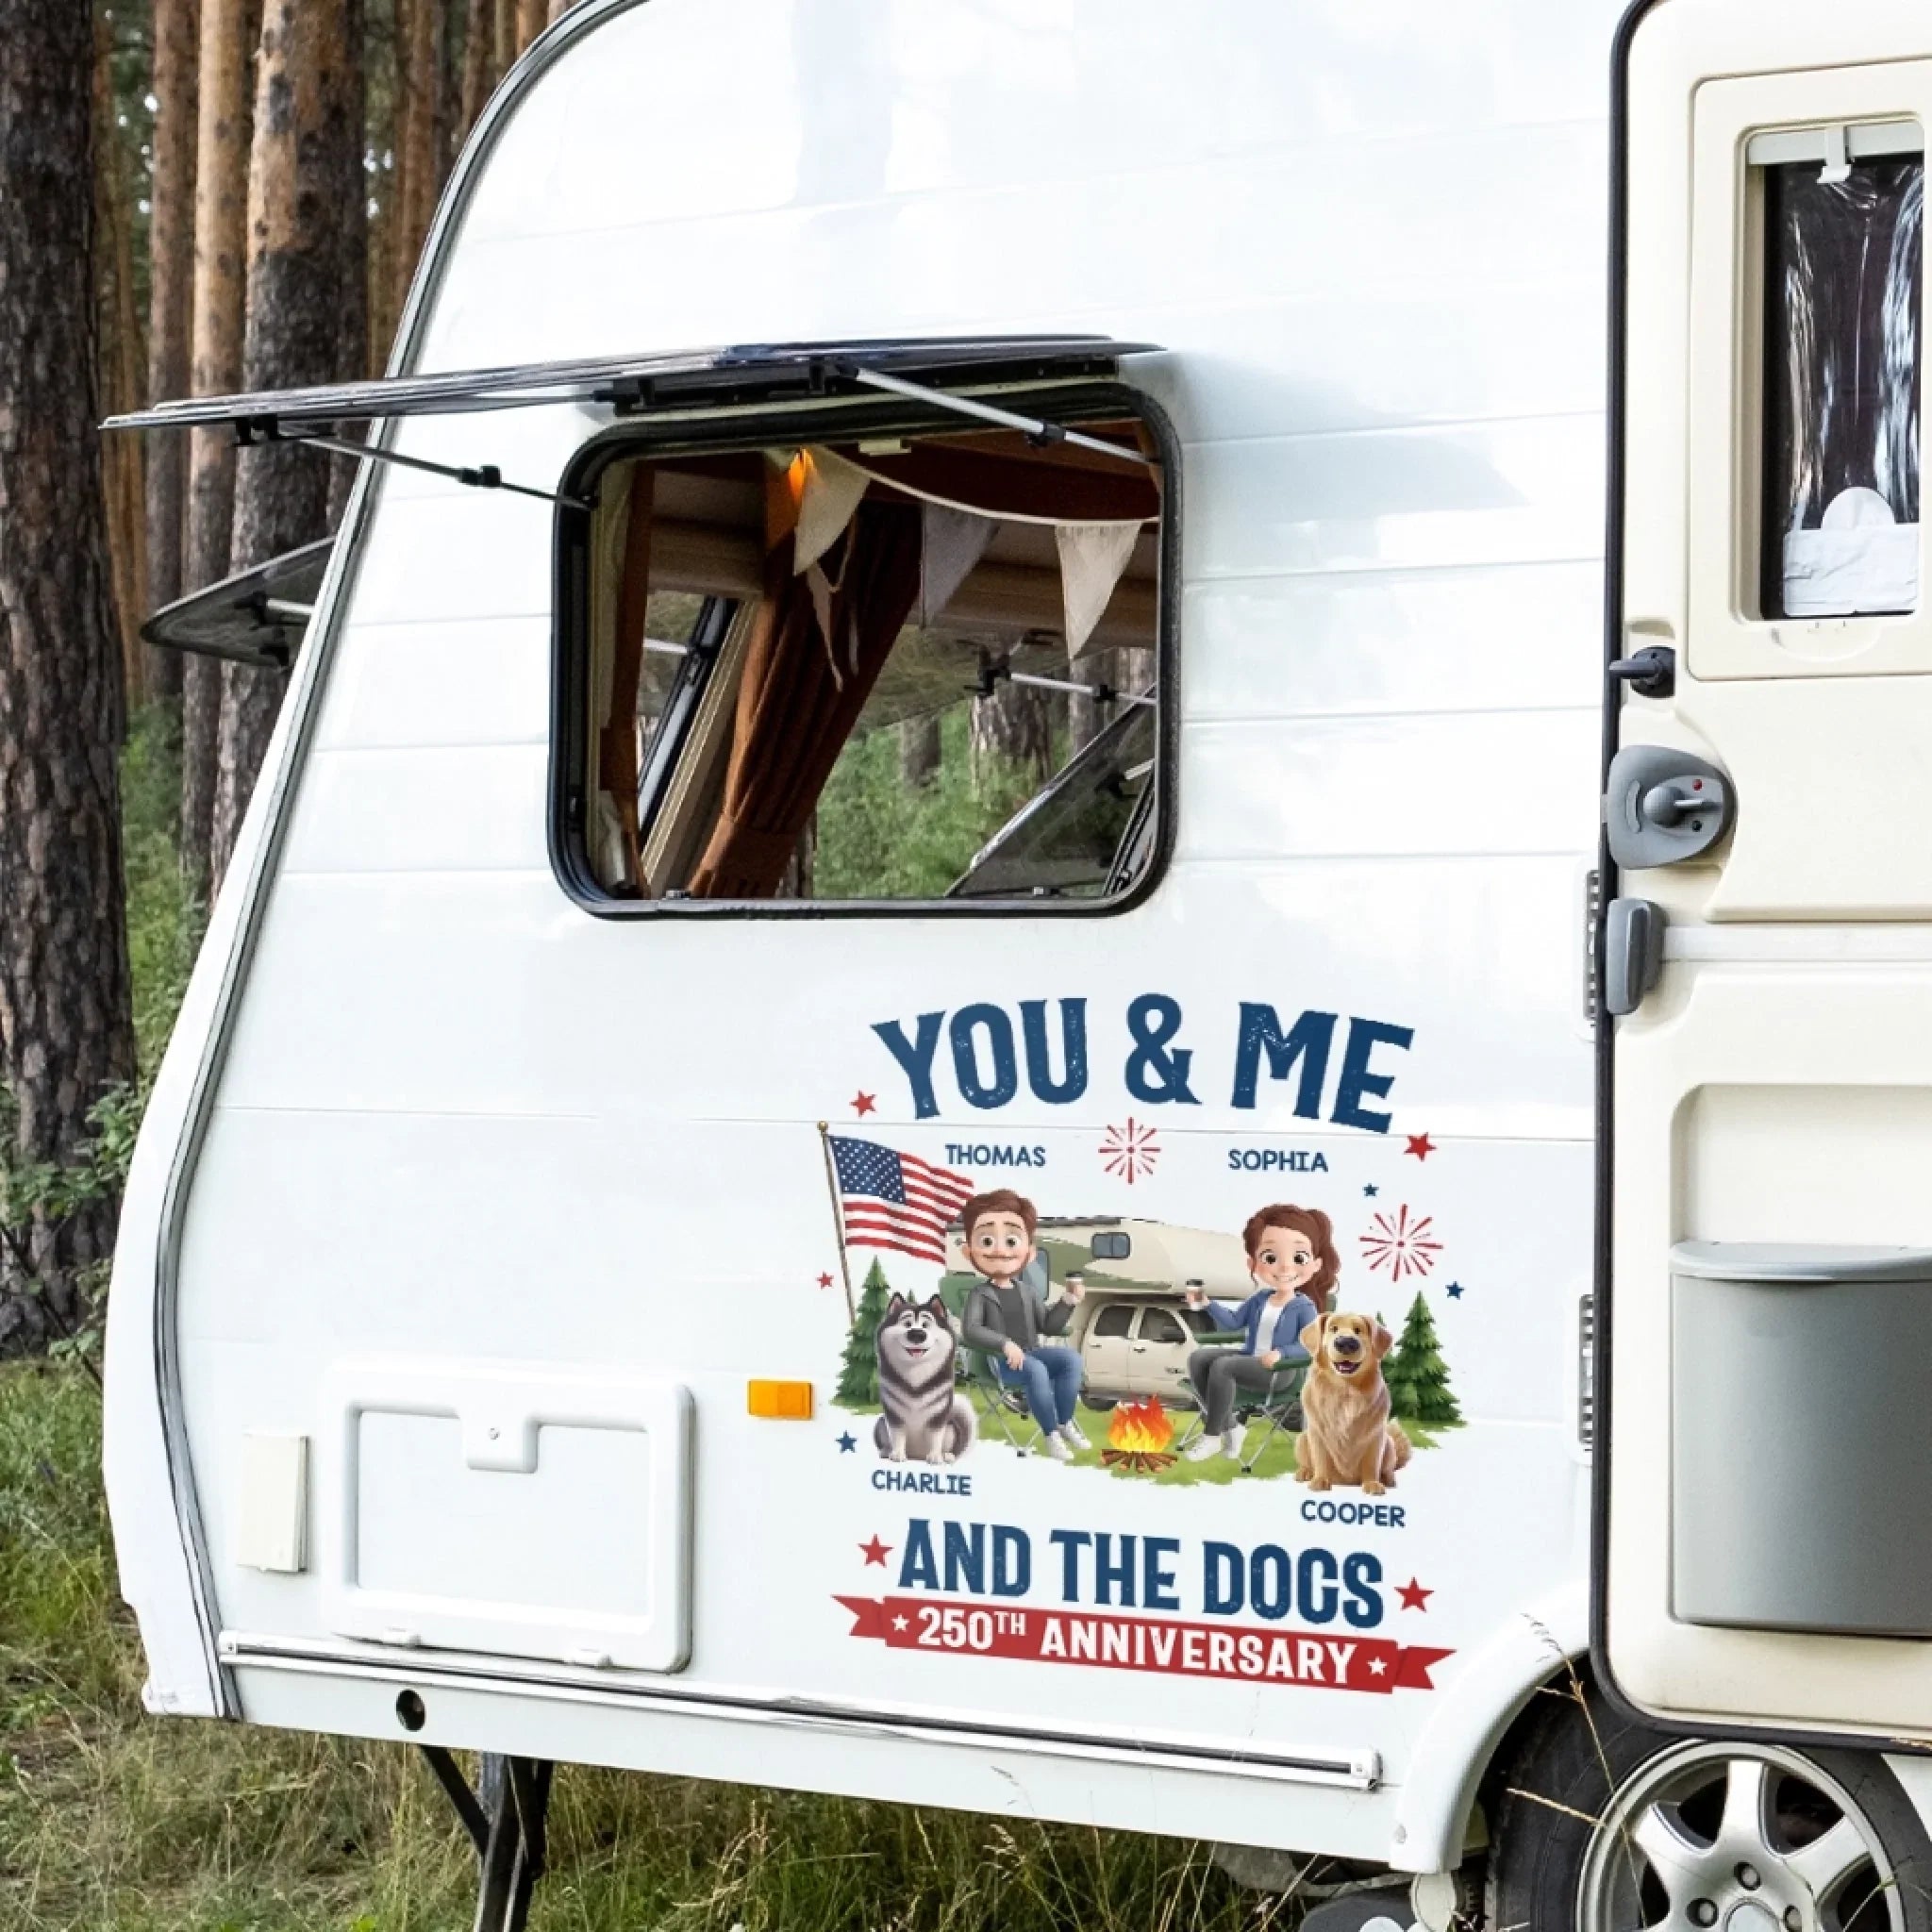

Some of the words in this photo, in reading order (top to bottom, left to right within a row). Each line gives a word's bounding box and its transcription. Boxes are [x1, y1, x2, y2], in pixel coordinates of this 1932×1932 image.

[871, 997, 1090, 1120] YOU
[1124, 993, 1203, 1105] &
[1229, 1001, 1416, 1135] ME
[944, 1144, 1046, 1167] THOMAS
[1227, 1148, 1329, 1173] SOPHIA
[871, 1469, 971, 1497] CHARLIE
[1301, 1499, 1405, 1527] COOPER
[897, 1518, 1031, 1597] AND
[1050, 1529, 1180, 1610] THE
[1202, 1541, 1384, 1629] DOGS
[918, 1607, 1025, 1650] 250TH
[1040, 1616, 1357, 1684] ANNIVERSARY
